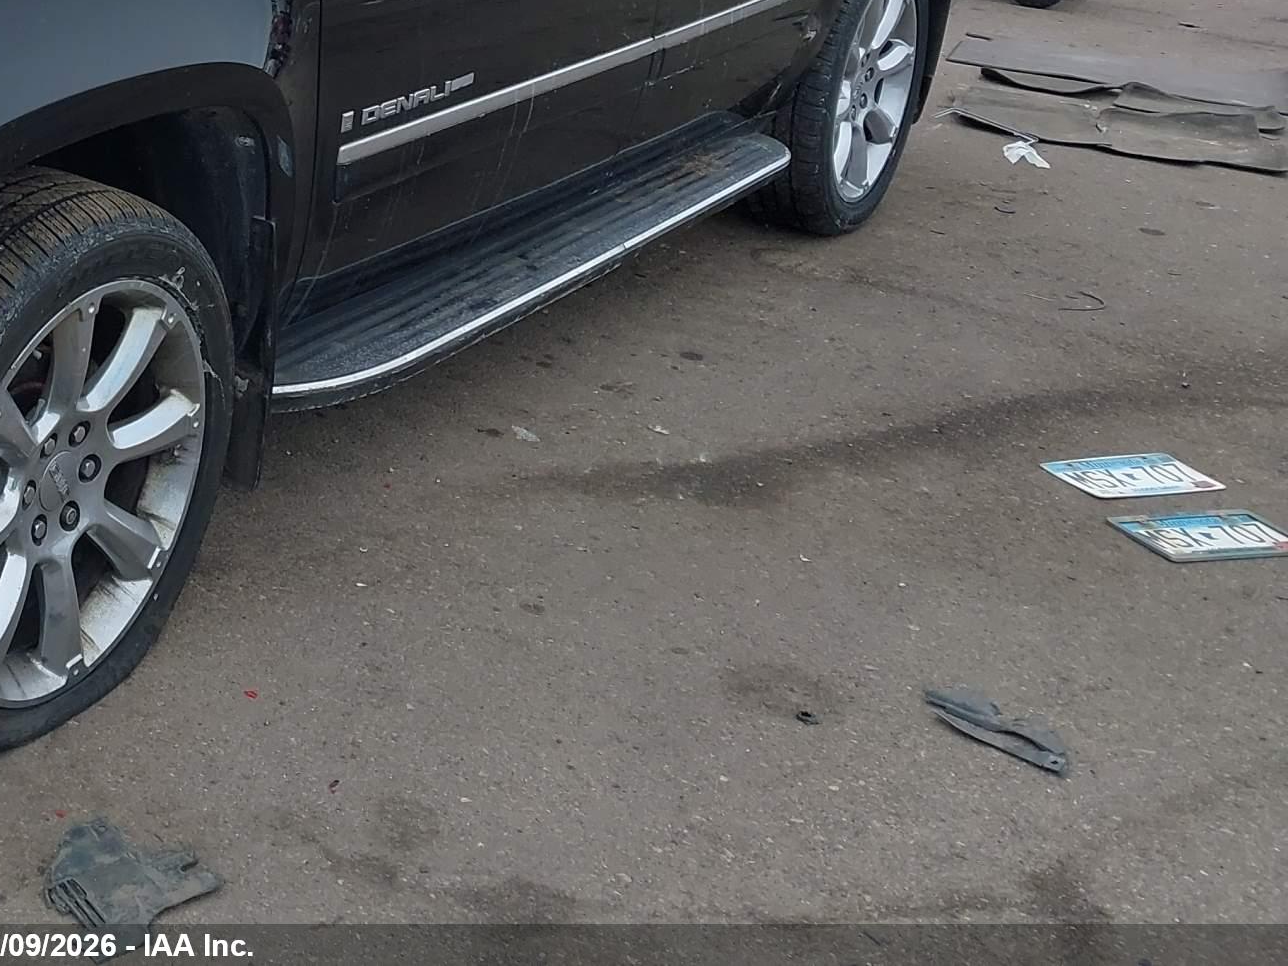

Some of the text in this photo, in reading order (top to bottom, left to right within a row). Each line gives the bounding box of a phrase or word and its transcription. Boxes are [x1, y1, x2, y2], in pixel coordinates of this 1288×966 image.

[360, 80, 453, 126] DENALI
[1063, 463, 1198, 490] MSX 707
[1135, 522, 1280, 549] MSX 707
